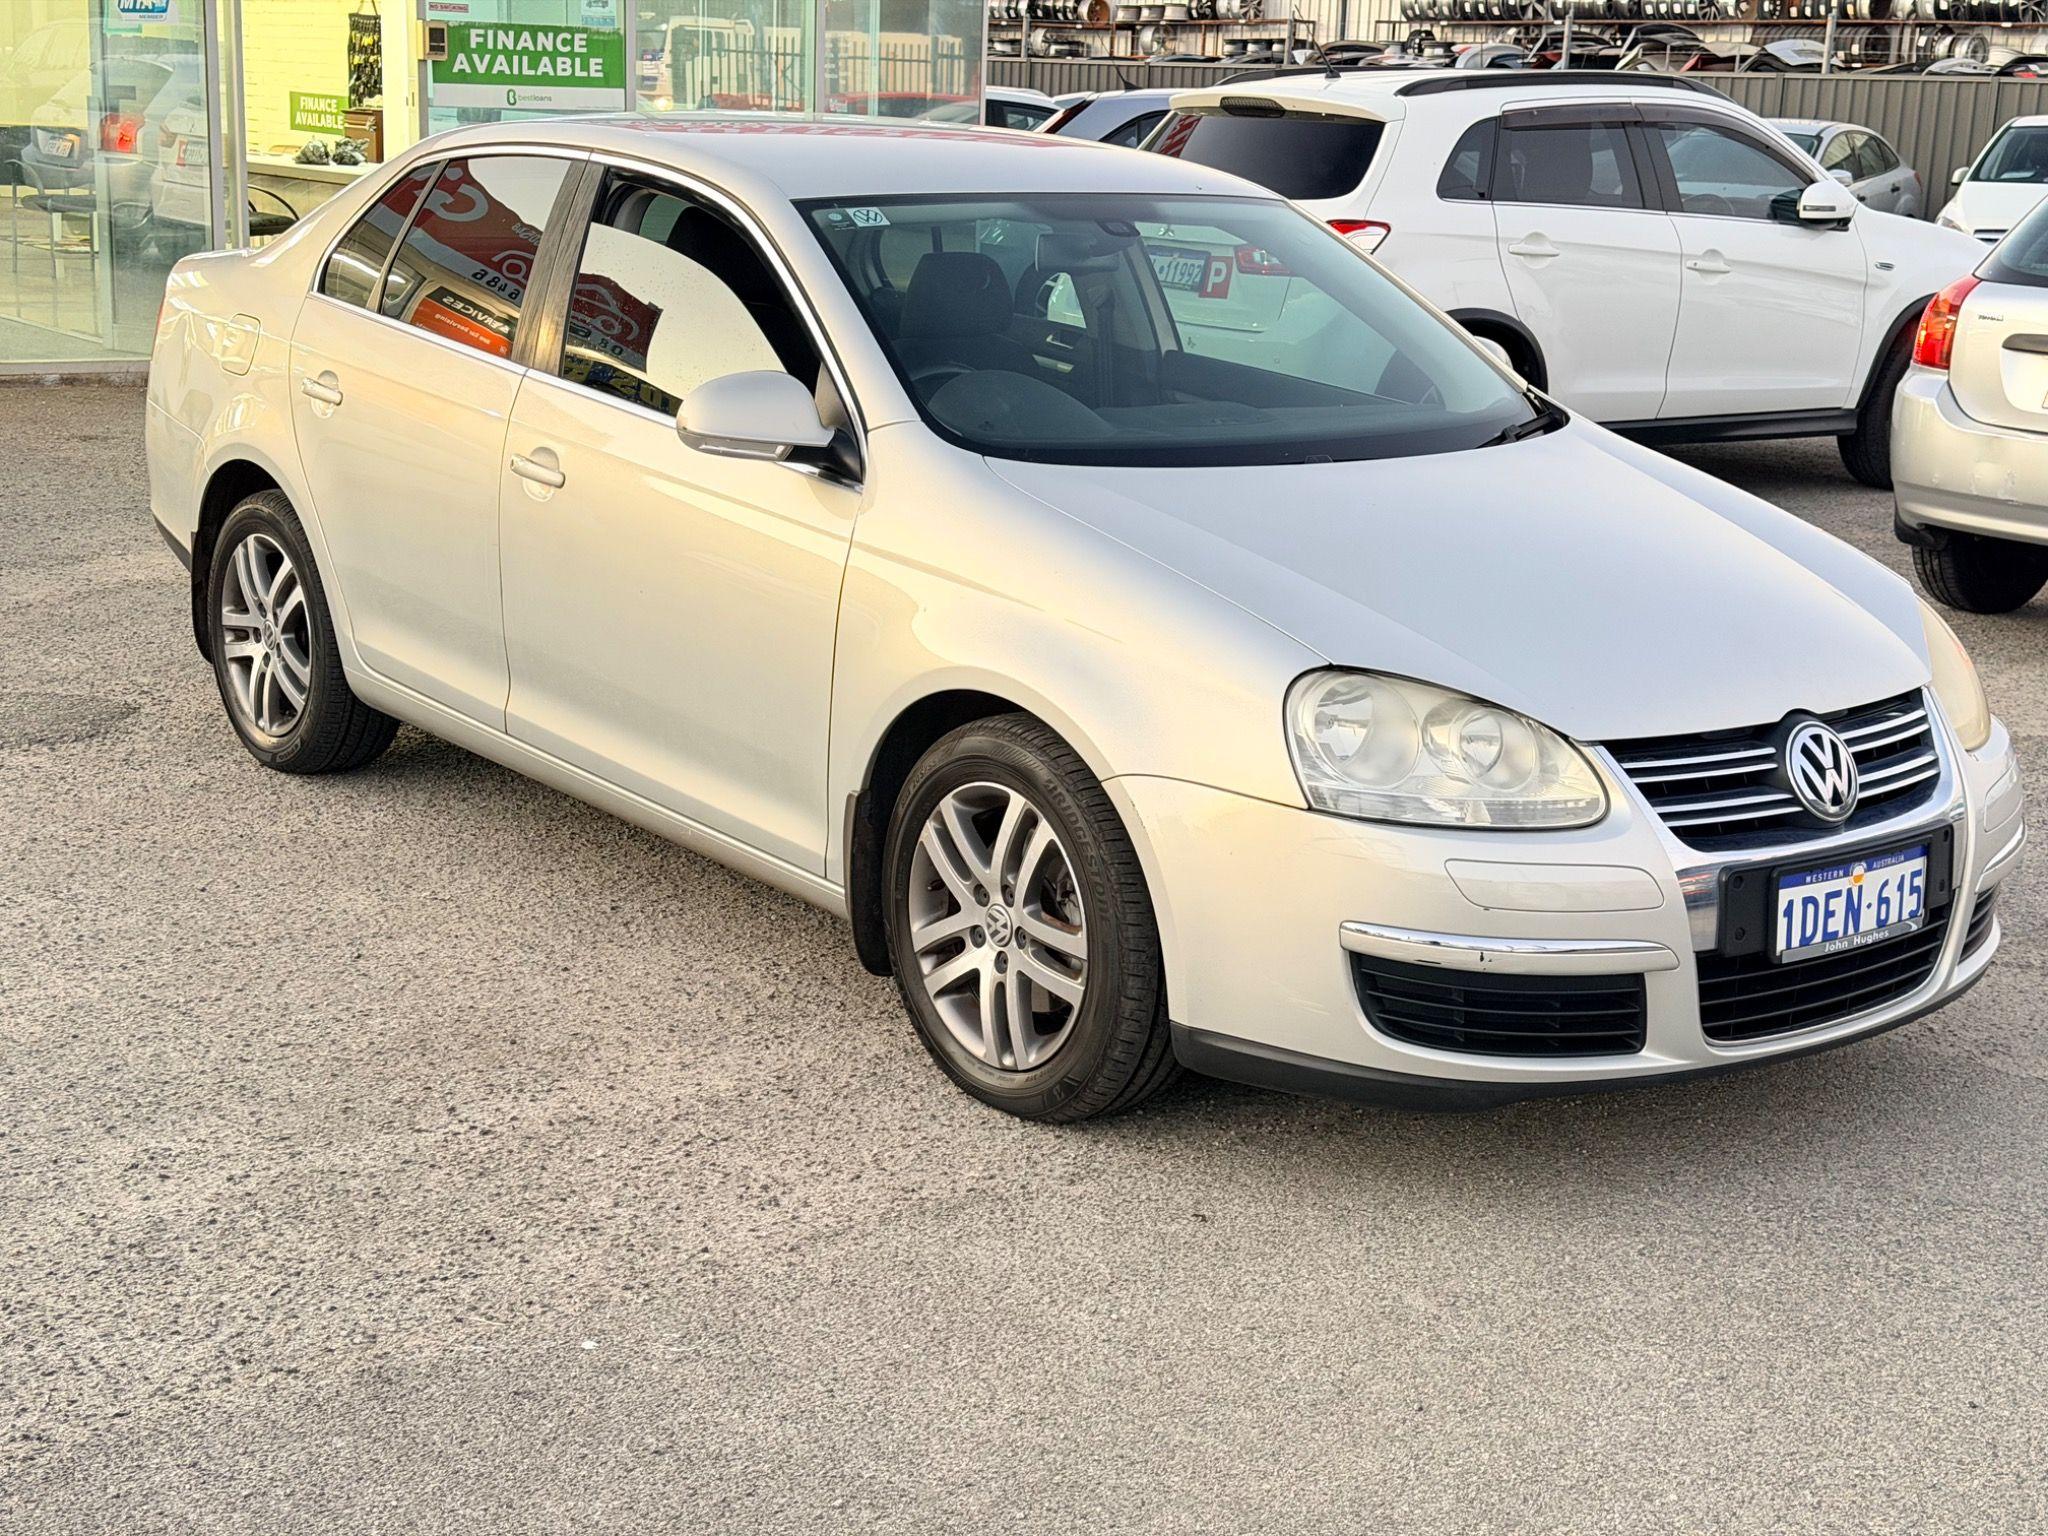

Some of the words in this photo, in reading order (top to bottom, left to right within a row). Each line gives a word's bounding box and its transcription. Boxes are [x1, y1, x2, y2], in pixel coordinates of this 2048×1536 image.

[469, 28, 588, 53] FINANCE
[452, 52, 604, 77] AVAILABLE
[300, 96, 338, 113] FINANCE
[295, 111, 345, 130] AVAILABLE
[1206, 261, 1227, 293] P
[1805, 869, 1844, 884] WESTERN
[1872, 854, 1906, 869] AUSTRALIA
[1824, 939, 1848, 953] John
[1853, 930, 1890, 947] Hughes
